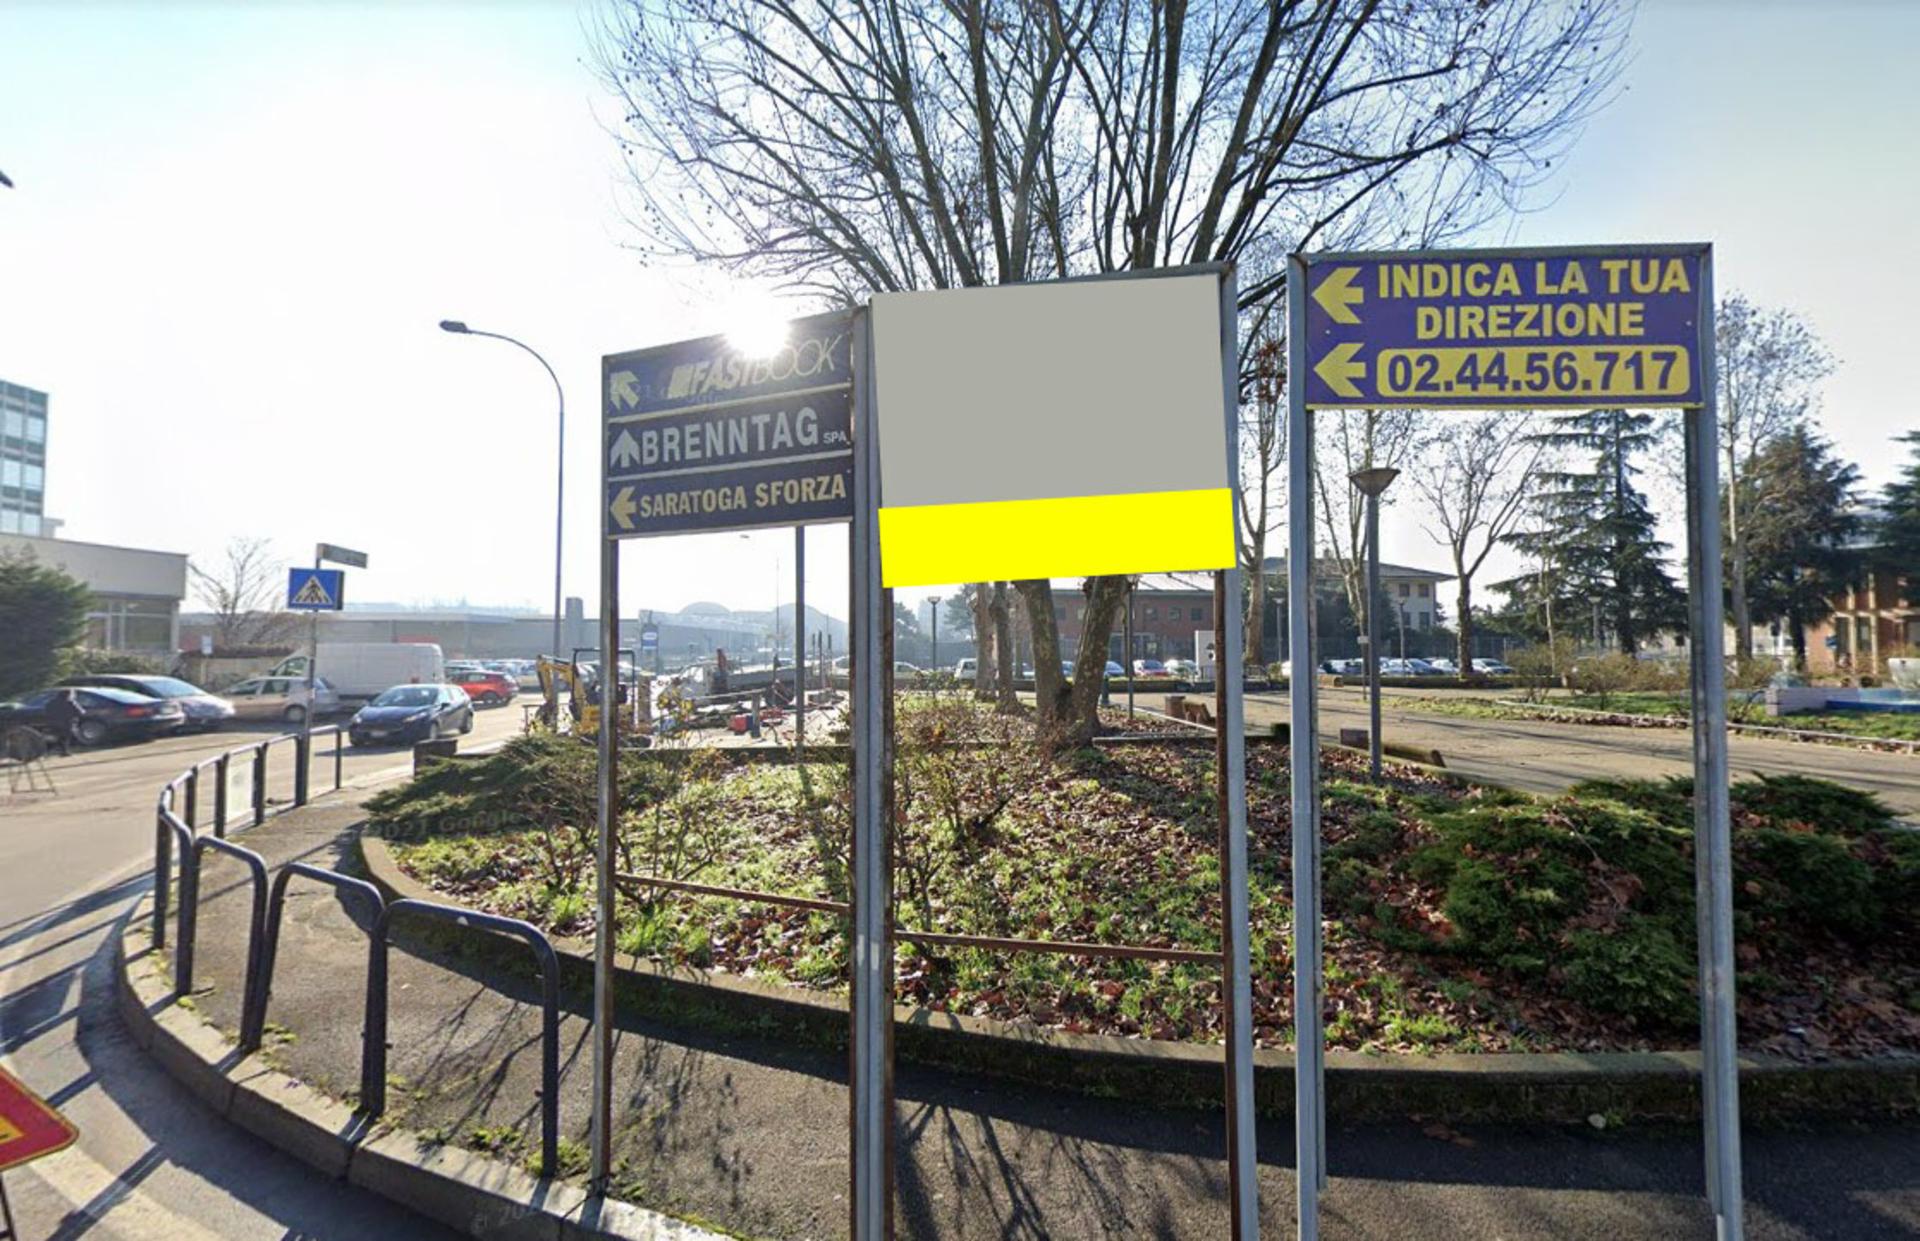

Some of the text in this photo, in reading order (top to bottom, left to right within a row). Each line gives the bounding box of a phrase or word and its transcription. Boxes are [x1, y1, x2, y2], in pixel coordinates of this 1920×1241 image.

[1378, 258, 1692, 298] INDICA LA TUA
[1416, 303, 1645, 340] DIREZIONE
[1387, 350, 1678, 392] 02.44.56.717
[641, 407, 847, 466] BRENNTAG SPA
[640, 473, 846, 518] SARATOGA SFORZA
